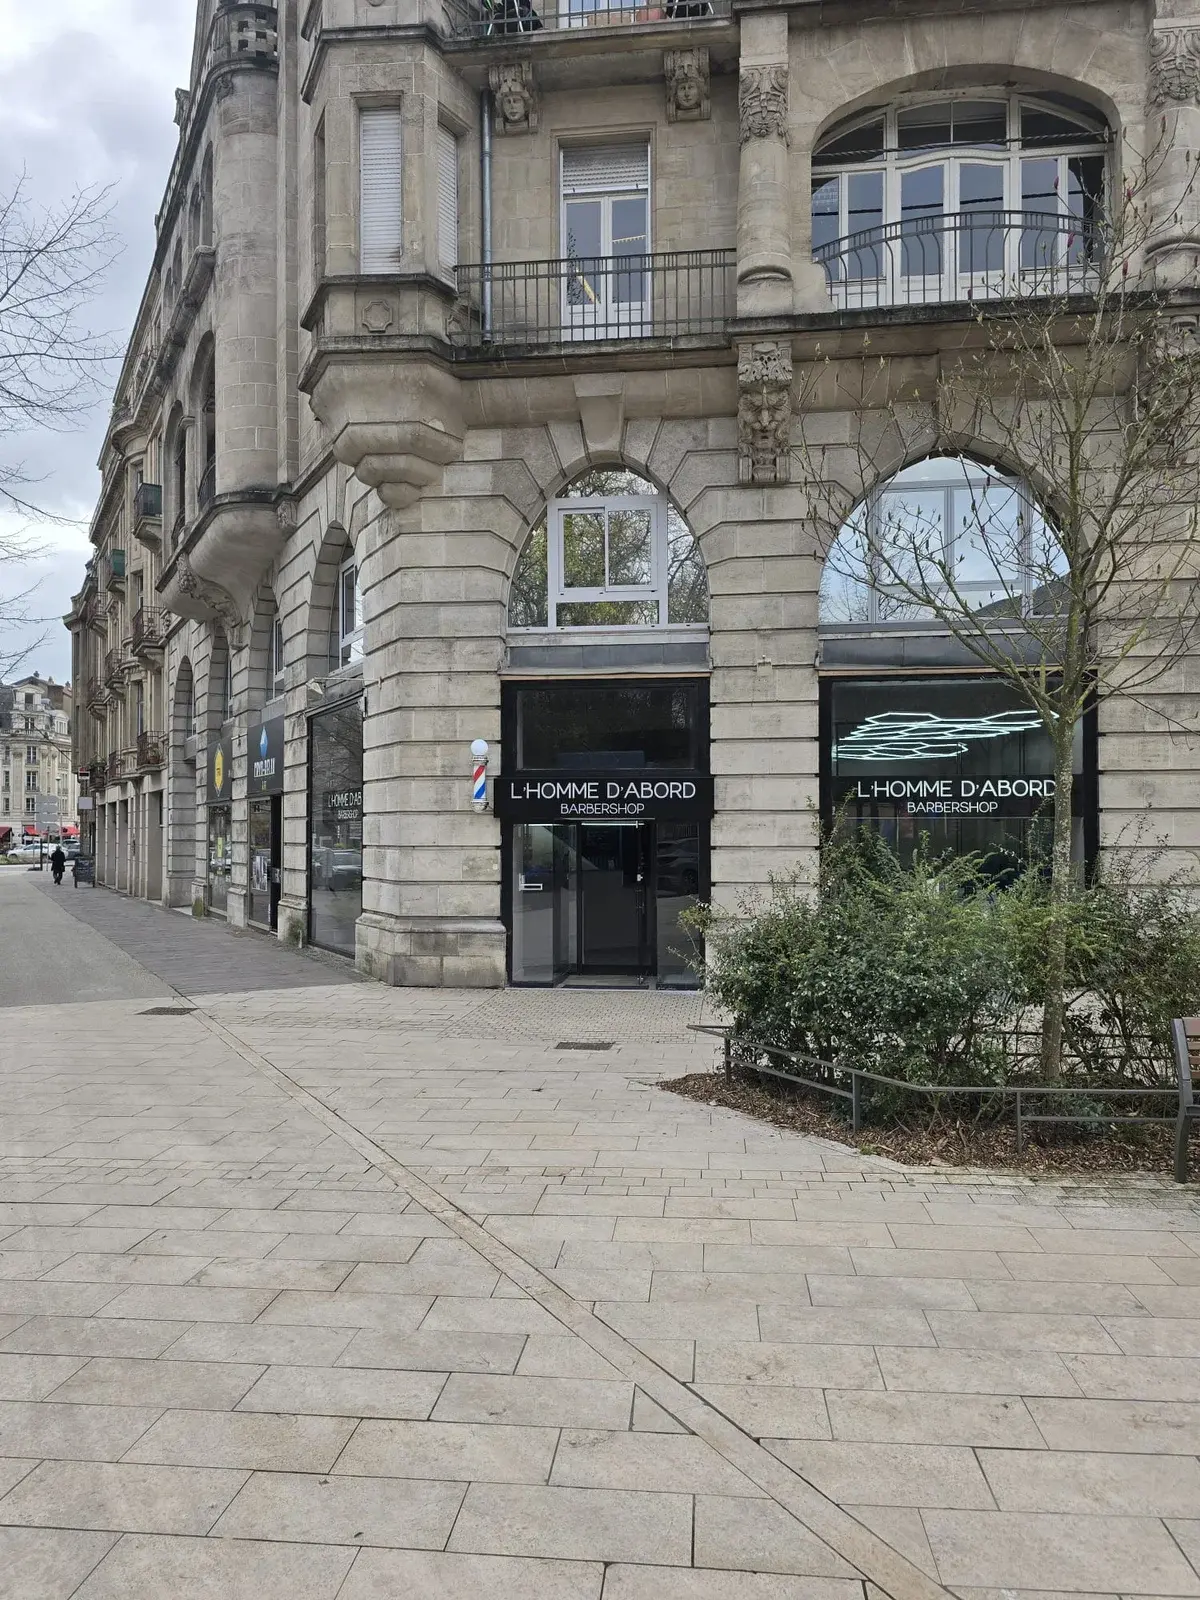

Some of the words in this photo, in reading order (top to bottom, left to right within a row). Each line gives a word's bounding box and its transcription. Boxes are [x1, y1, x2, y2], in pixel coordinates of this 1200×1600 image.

[510, 782, 600, 799] L'HOMME
[606, 782, 697, 799] D'ABORD
[857, 780, 953, 798] L'HOMME
[961, 780, 1056, 797] D'ABORD
[560, 803, 645, 815] BARBERSHOP
[907, 801, 999, 814] BARBERSHOP
